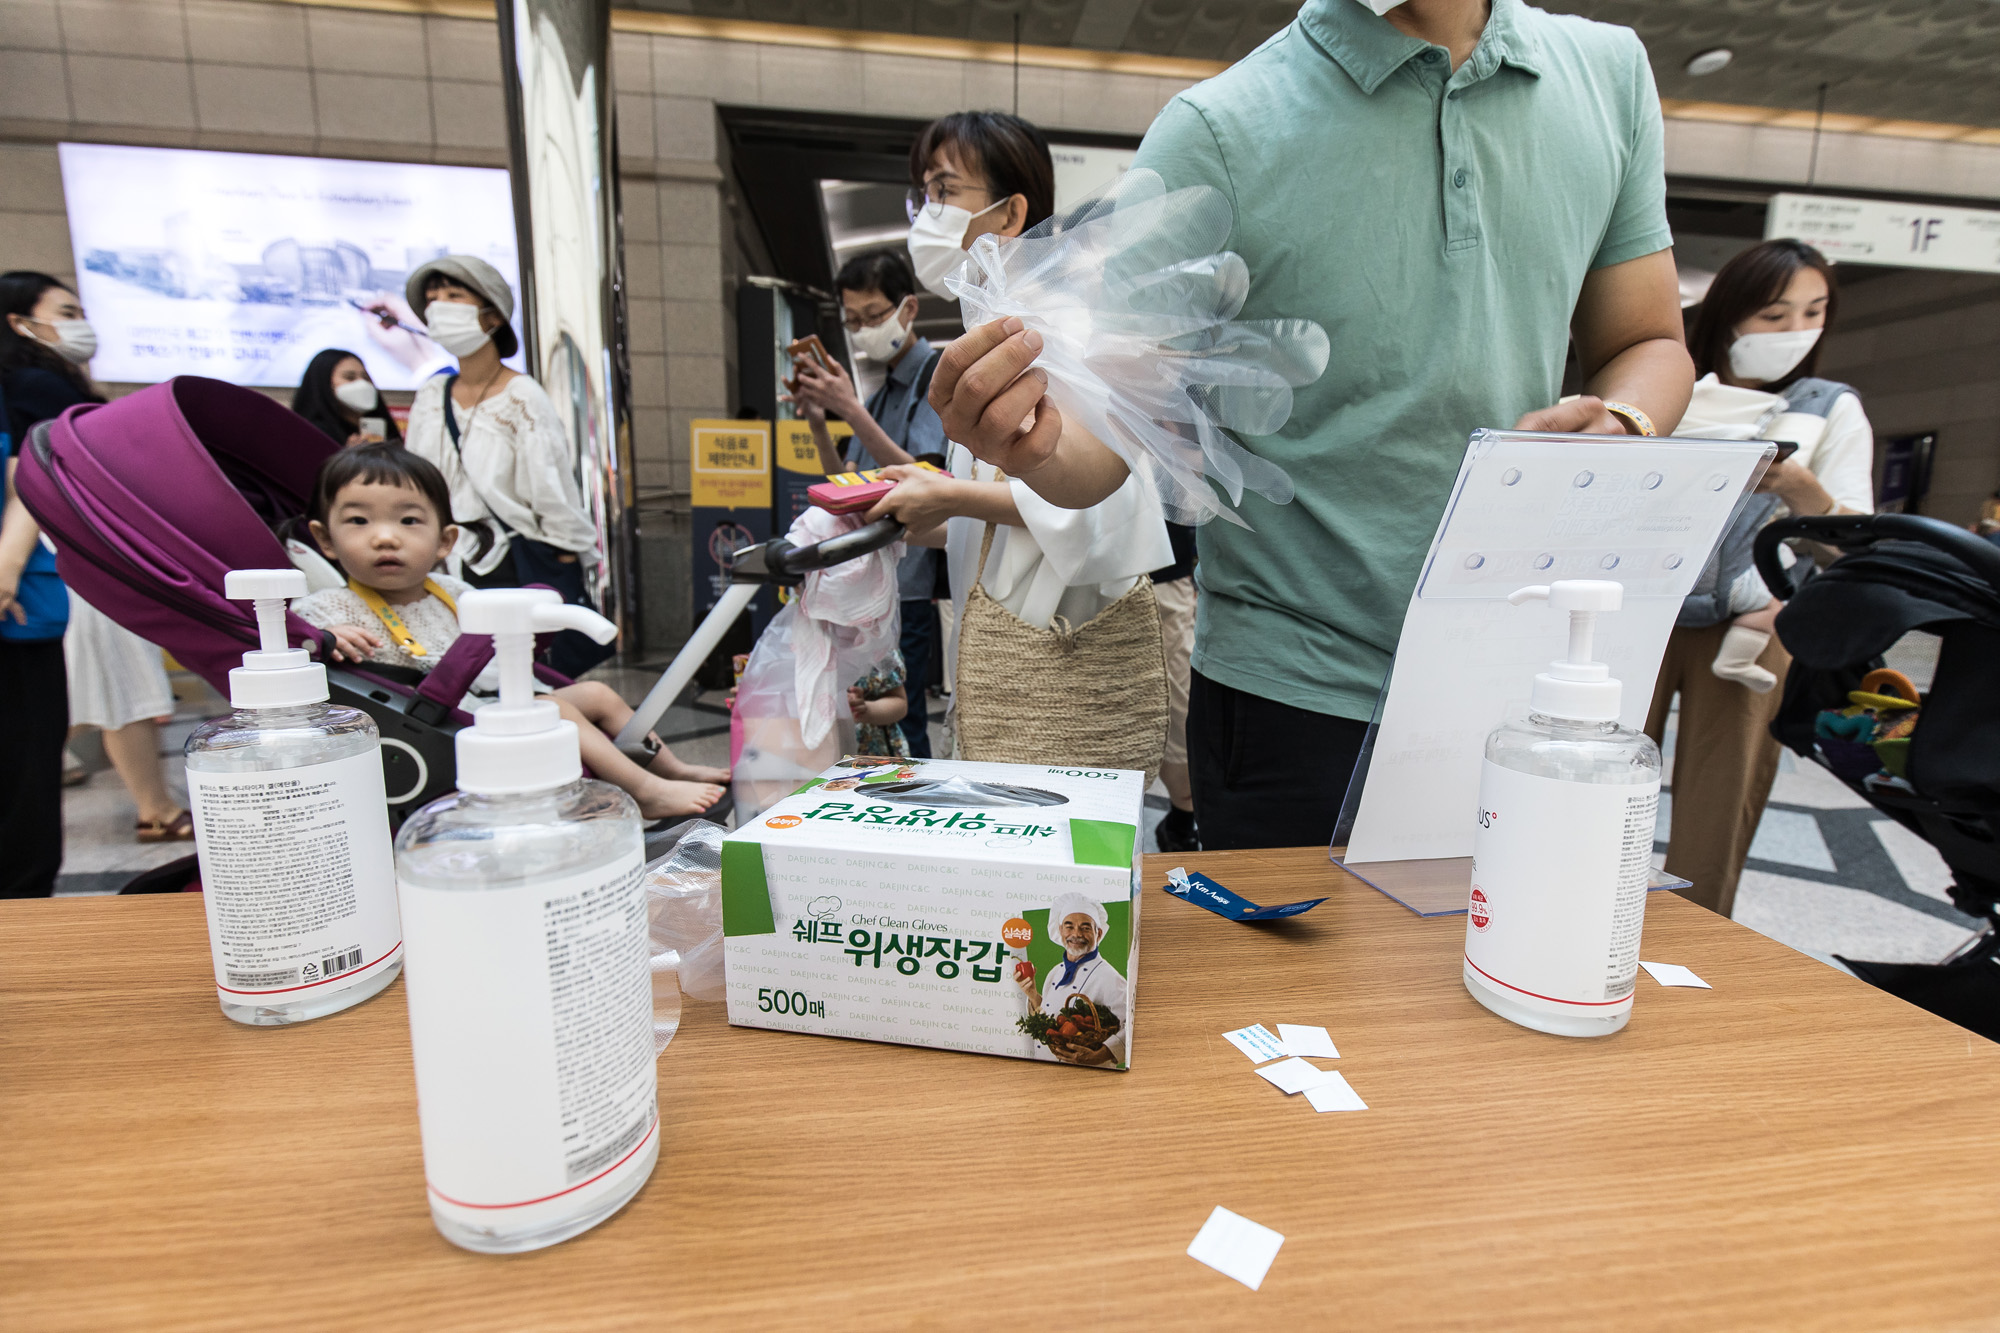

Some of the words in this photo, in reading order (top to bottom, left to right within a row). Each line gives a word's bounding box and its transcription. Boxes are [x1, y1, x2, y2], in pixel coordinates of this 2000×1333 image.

[1910, 217, 1943, 253] 1F
[1047, 768, 1119, 781] 500매
[802, 802, 995, 829] 위생장갑
[991, 823, 1057, 838] 쉐프
[851, 914, 877, 927] Chef
[879, 915, 909, 929] Clean
[912, 919, 948, 933] Gloves
[344, 943, 360, 952] KOREA
[792, 919, 844, 945] 쉐프
[844, 929, 1011, 983] 위생장갑
[1003, 927, 1032, 941] 실속형
[757, 988, 825, 1019] 500매
